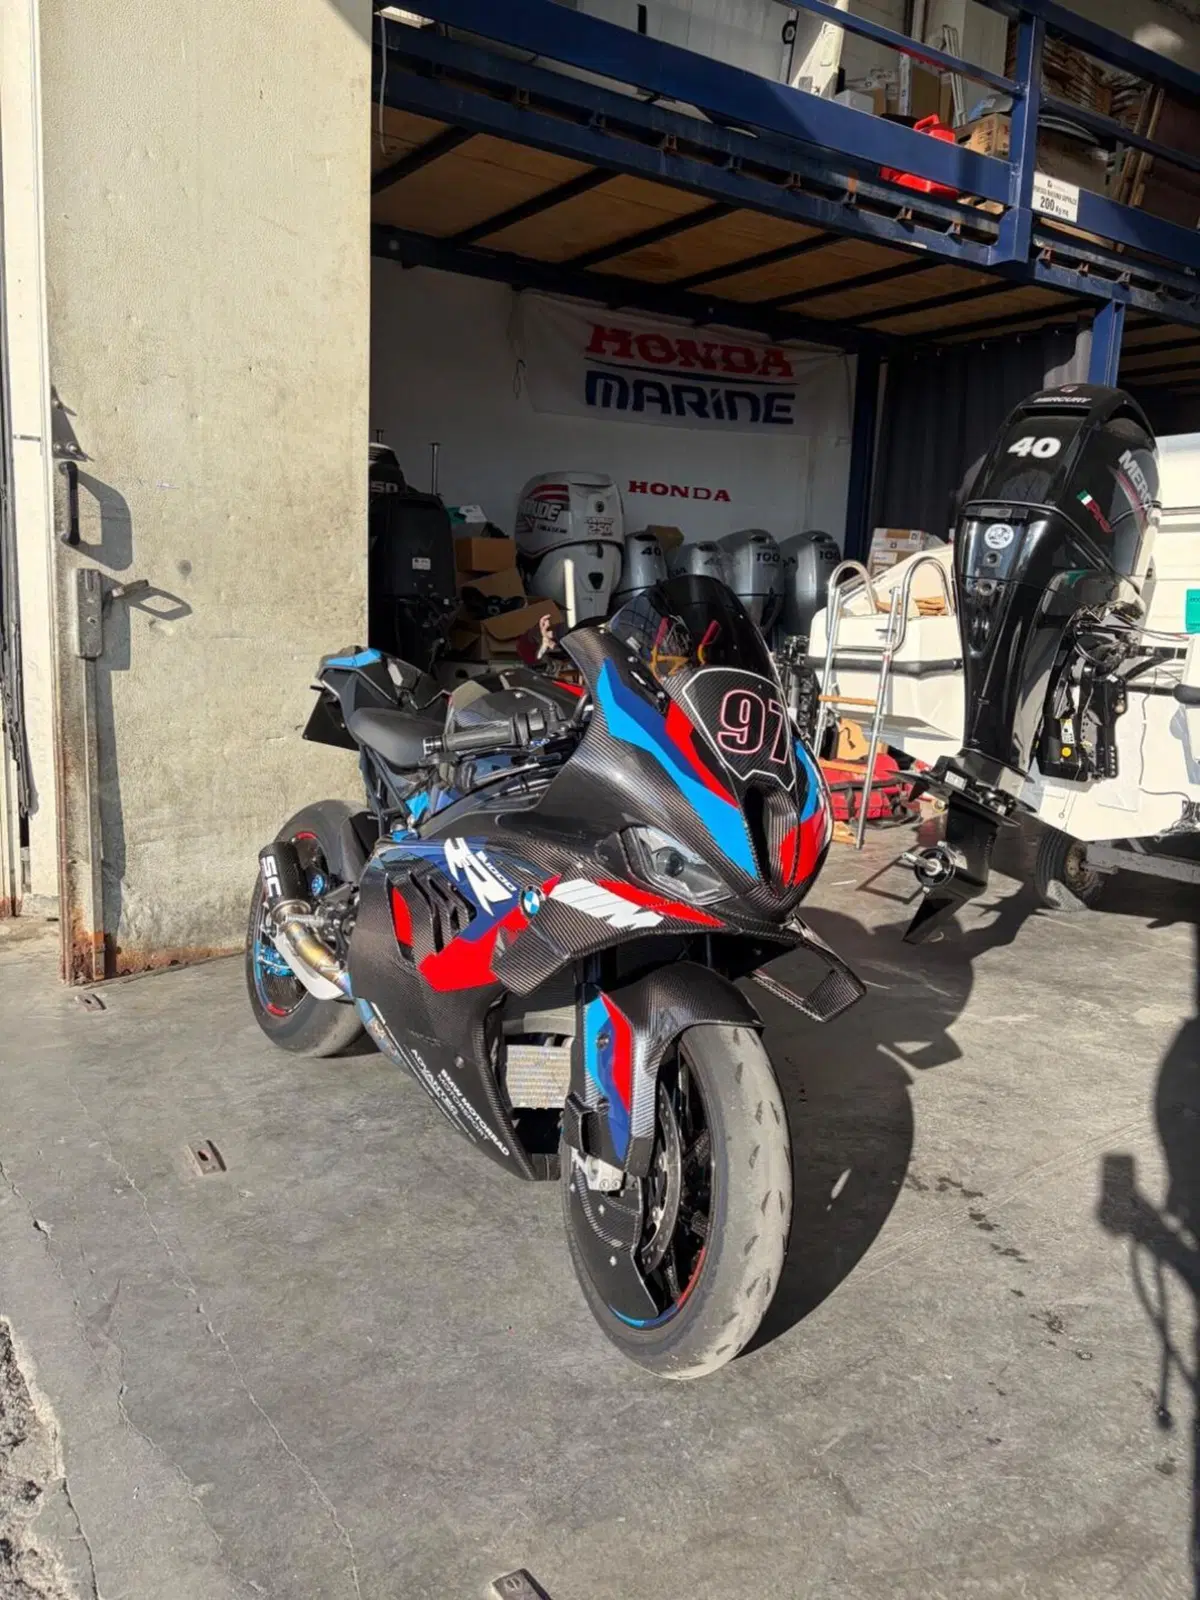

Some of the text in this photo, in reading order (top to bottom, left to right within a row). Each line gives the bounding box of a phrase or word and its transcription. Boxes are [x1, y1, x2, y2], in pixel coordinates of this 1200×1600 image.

[1040, 196, 1055, 212] 200
[584, 325, 794, 377] HONDA
[1007, 436, 1062, 459] 40
[628, 480, 732, 502] HONDA
[1118, 449, 1155, 511] MERC
[756, 551, 780, 562] 100
[717, 689, 788, 765] 97
[261, 855, 282, 898] SC
[437, 1073, 490, 1141] MOTORSPORT
[440, 1068, 463, 1098] BMW
[461, 1097, 510, 1157] MOTORRAD
